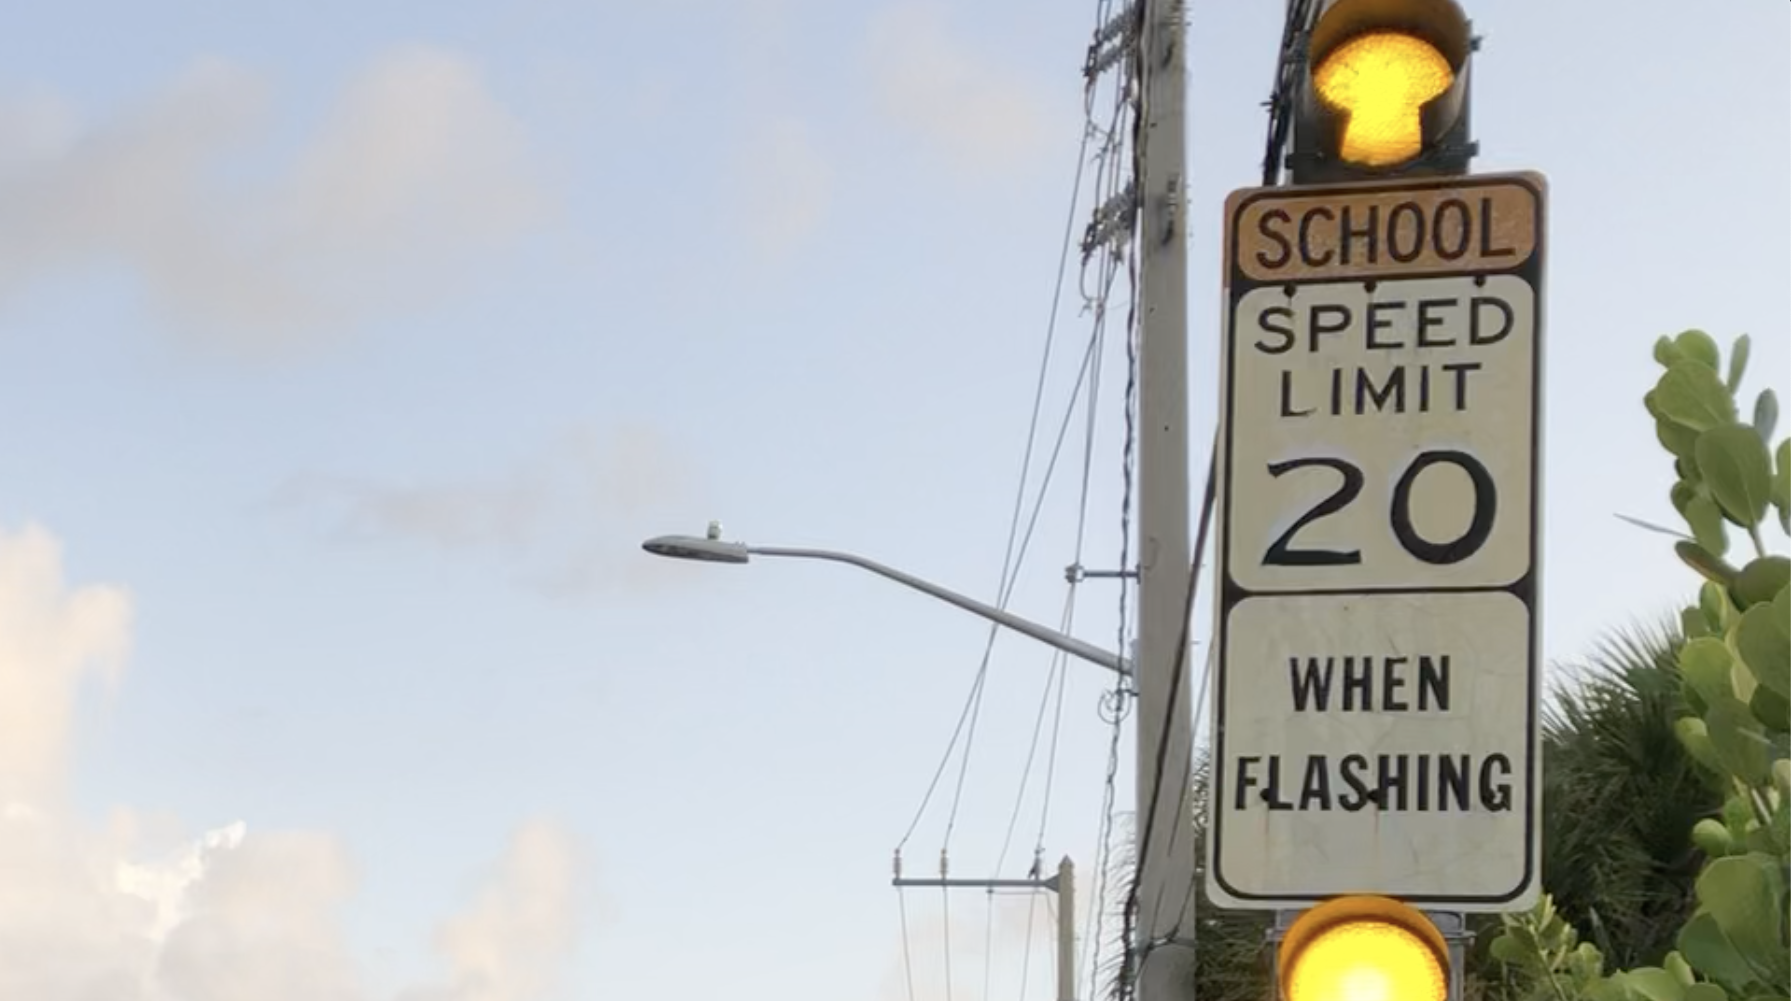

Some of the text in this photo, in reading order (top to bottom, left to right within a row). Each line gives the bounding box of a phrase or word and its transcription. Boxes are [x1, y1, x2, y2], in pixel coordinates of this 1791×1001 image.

[1255, 197, 1516, 270] SCHOOL
[1254, 296, 1515, 355] SPEED
[1280, 362, 1483, 418] LIMIT
[1260, 449, 1498, 567] 20
[1289, 654, 1451, 713] WHEN
[1234, 752, 1513, 813] FLASHING
